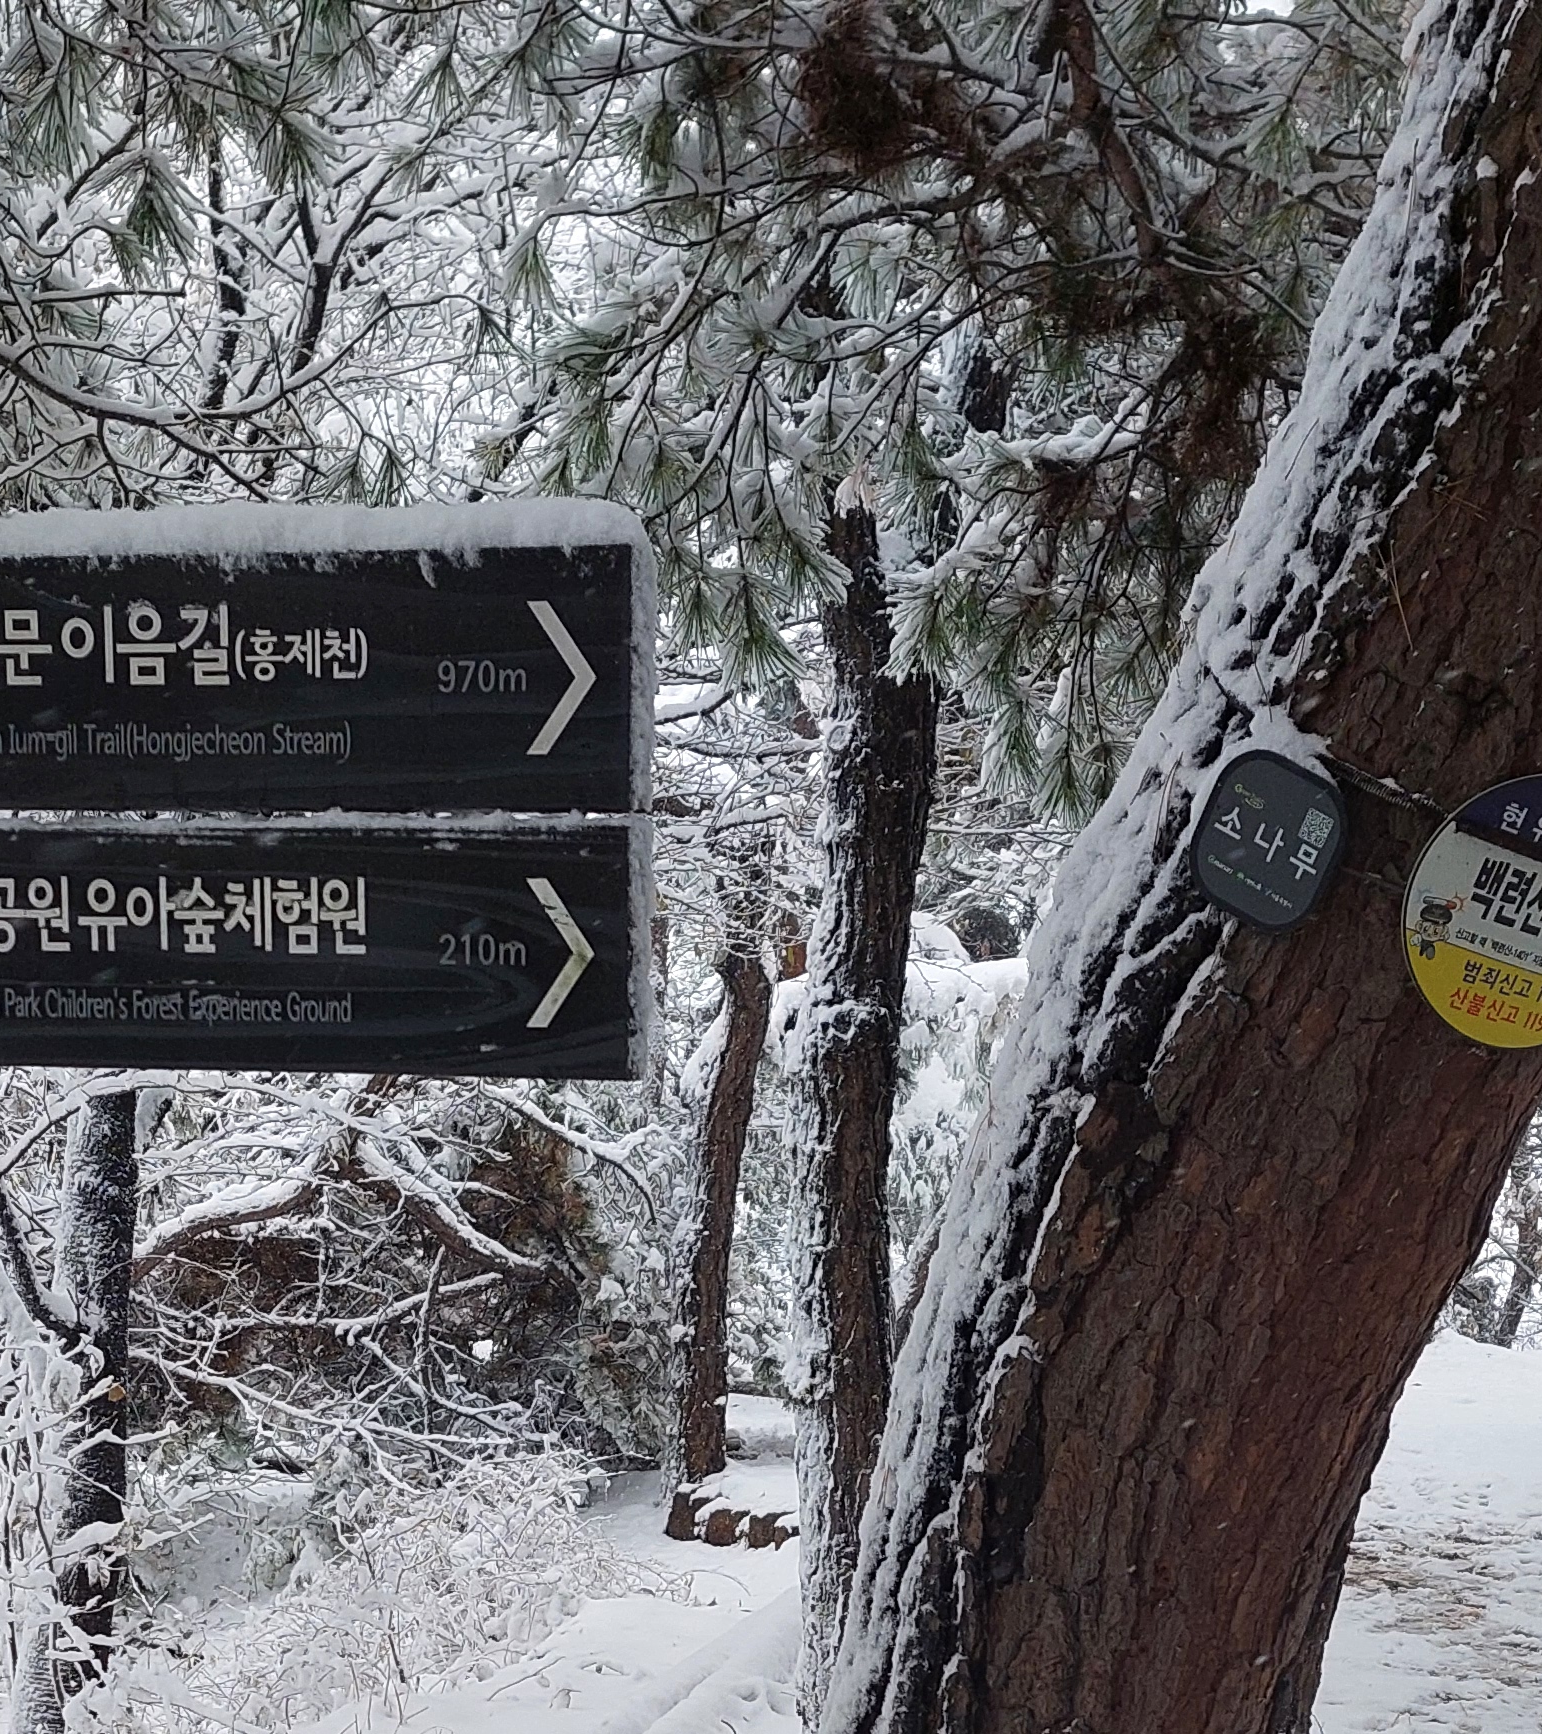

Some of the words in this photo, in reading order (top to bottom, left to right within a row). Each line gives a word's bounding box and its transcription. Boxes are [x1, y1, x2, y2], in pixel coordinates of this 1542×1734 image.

[437, 661, 527, 693] 970m
[83, 721, 265, 761] Trail(Hongjecheon
[272, 721, 352, 764] Stream)
[1500, 802, 1529, 835] 현
[1214, 806, 1319, 881] 소나무
[439, 933, 526, 967] 210m
[1462, 959, 1534, 999] 범죄신고
[4, 988, 42, 1018] Park
[45, 986, 128, 1019] Children's
[133, 990, 183, 1020] Forest
[189, 989, 282, 1026] Experience
[287, 992, 352, 1023] Ground
[1449, 987, 1520, 1024] 산불신고
